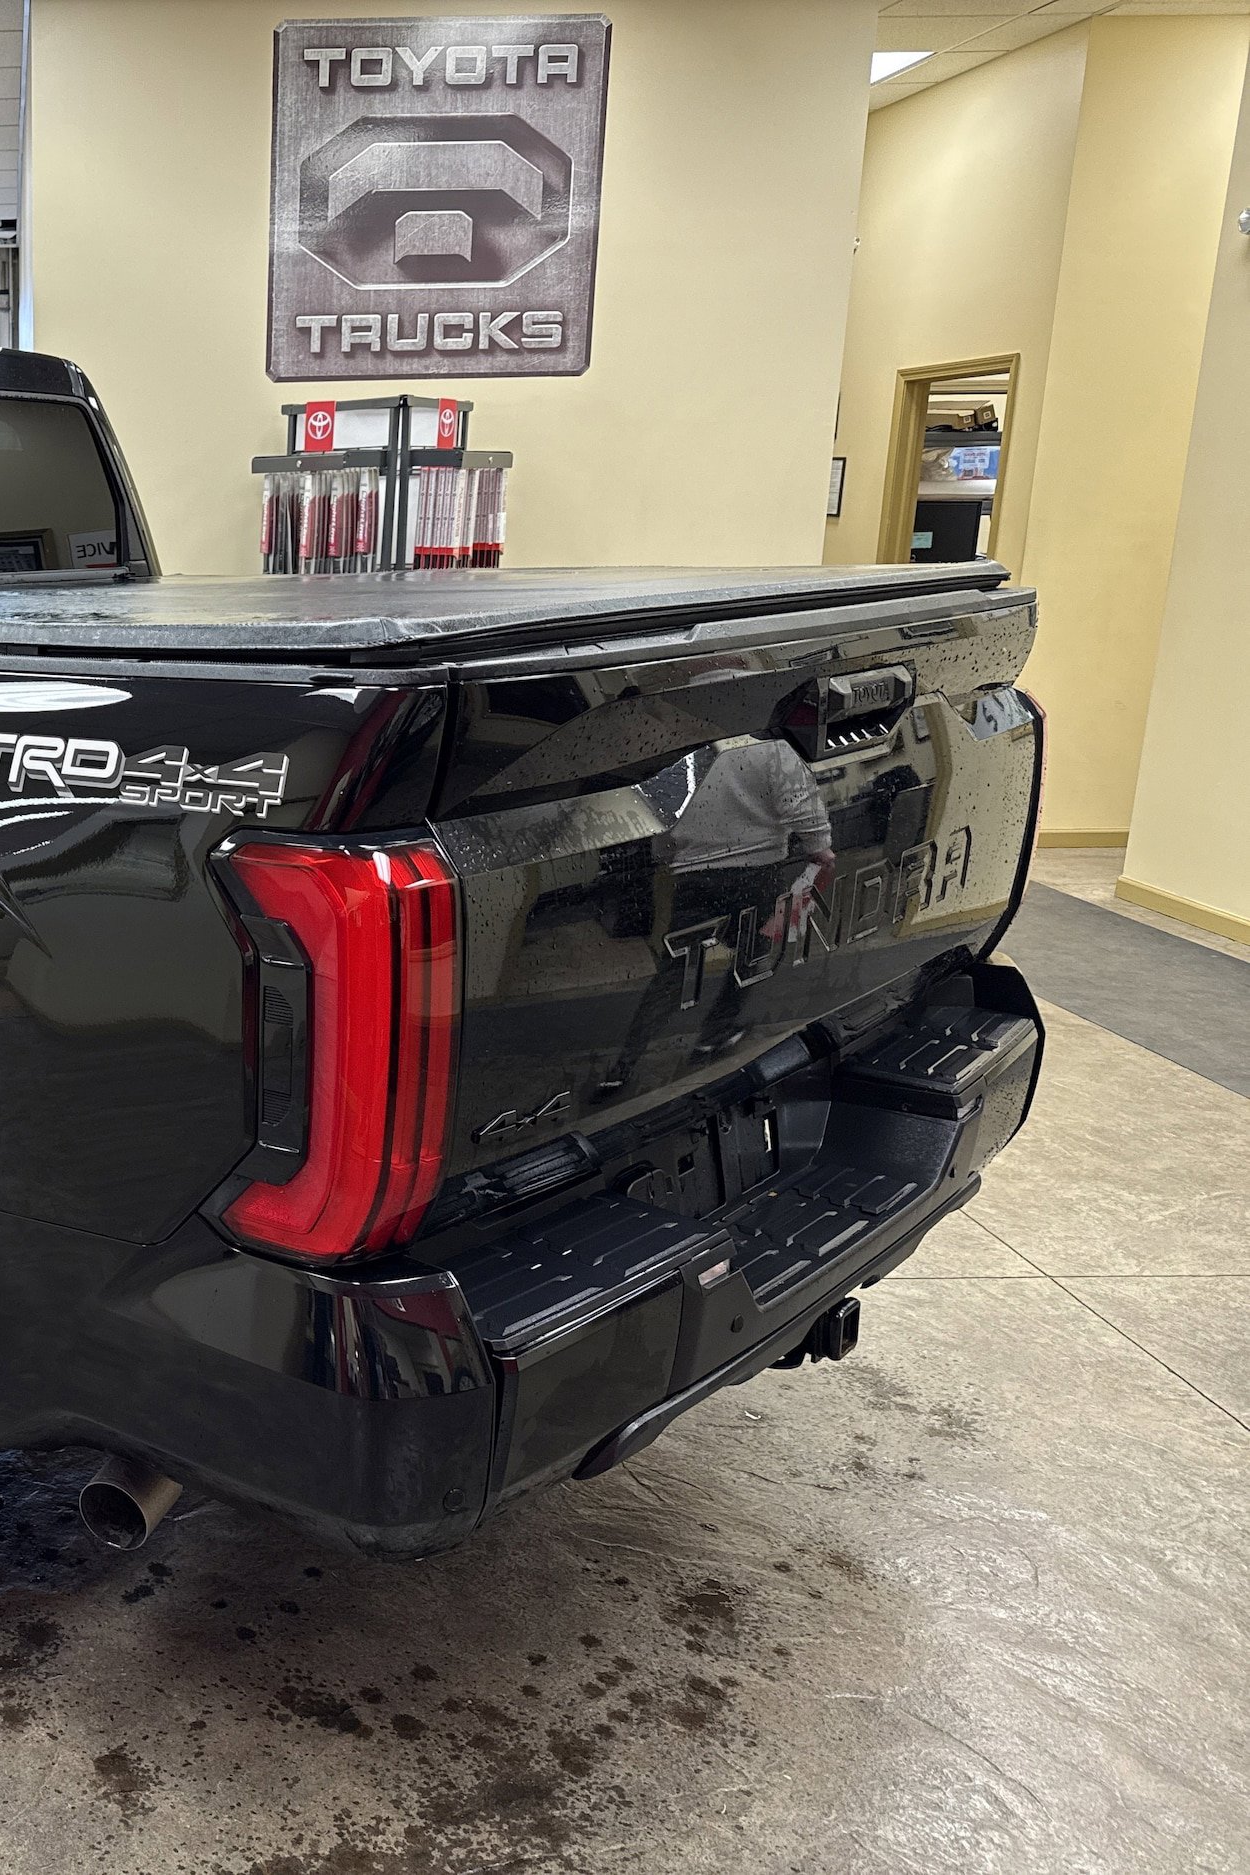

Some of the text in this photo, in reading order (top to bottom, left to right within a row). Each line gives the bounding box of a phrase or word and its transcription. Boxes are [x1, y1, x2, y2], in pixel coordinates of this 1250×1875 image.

[304, 43, 580, 88] TOYOTA
[296, 311, 565, 354] TRUCKS
[852, 682, 891, 705] TOYOTA
[119, 782, 282, 819] SPORT
[662, 824, 972, 1011] TUNDRA
